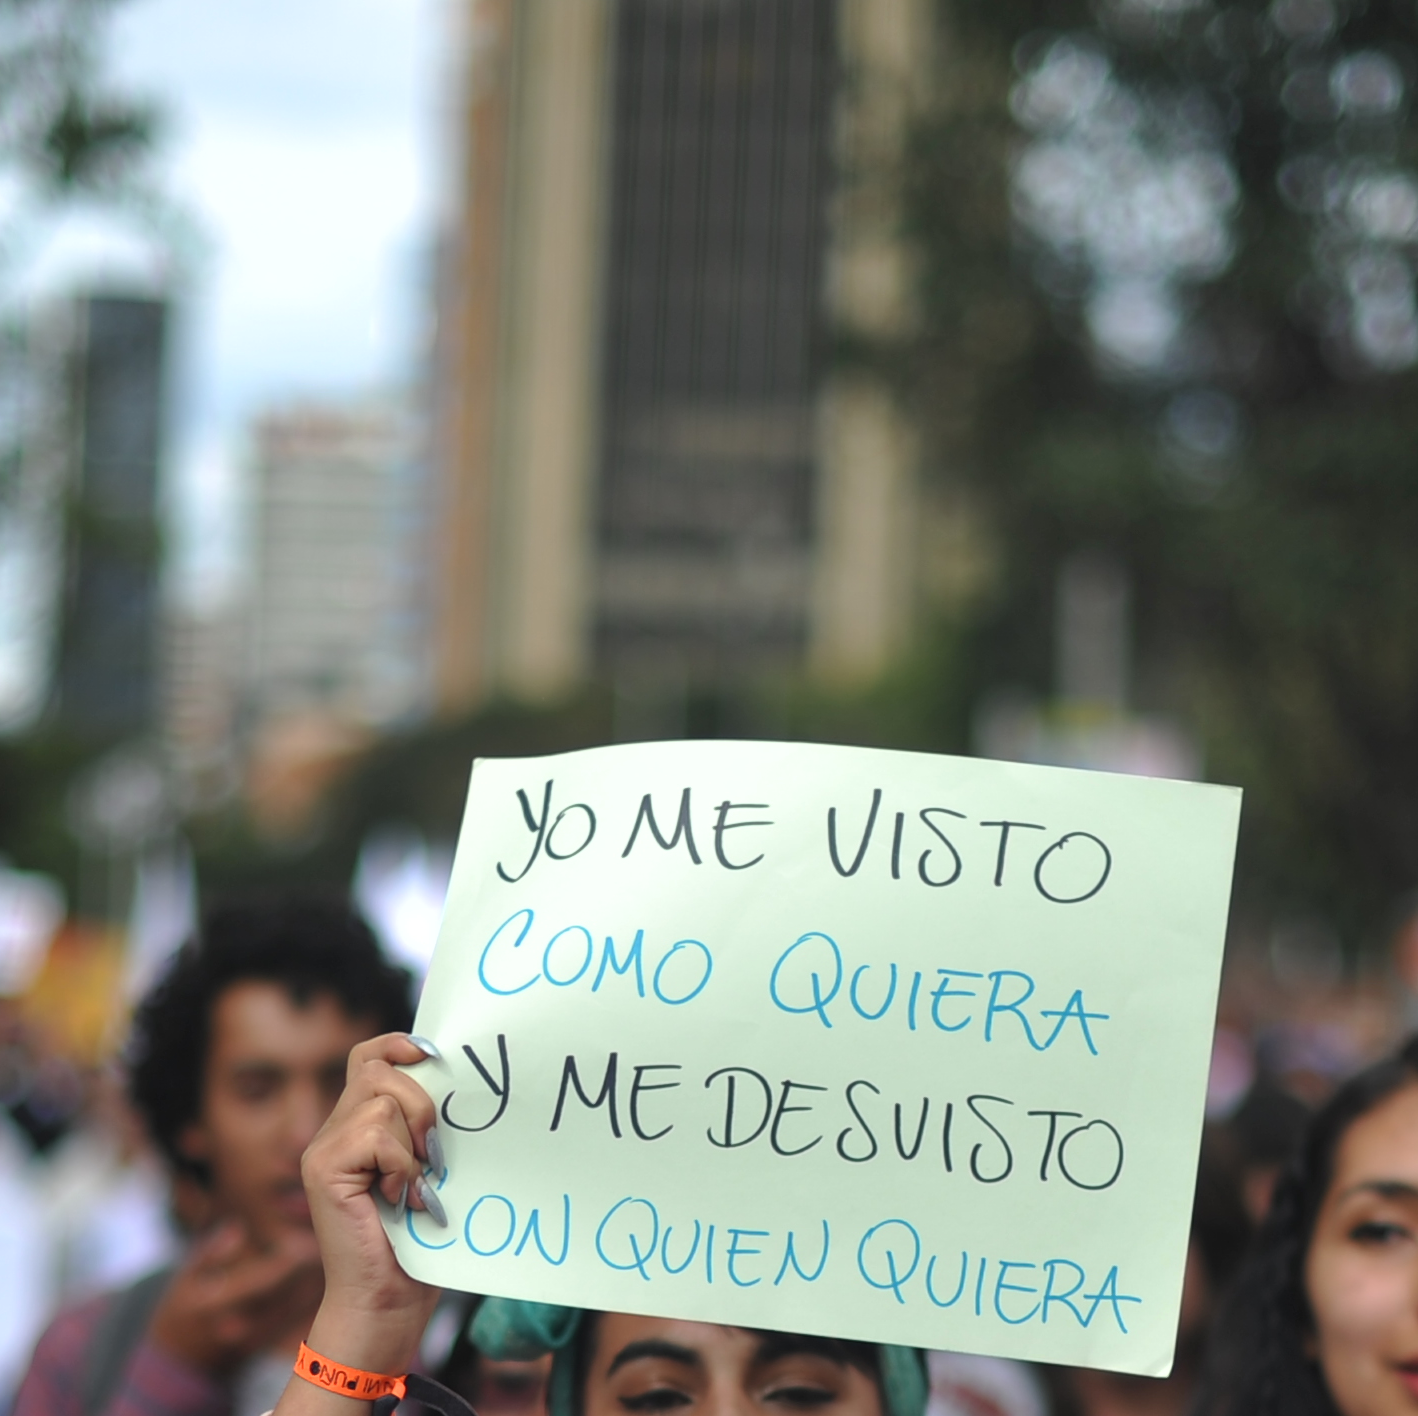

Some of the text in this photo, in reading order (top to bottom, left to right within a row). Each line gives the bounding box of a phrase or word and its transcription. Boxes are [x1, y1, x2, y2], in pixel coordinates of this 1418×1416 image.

[621, 787, 774, 870] ME
[828, 789, 1112, 904] VISTO
[478, 909, 1110, 1056] COMO QUIERA
[550, 1052, 682, 1140] ME
[705, 1067, 1123, 1190] DESVISTO
[596, 1197, 829, 1287] QUIEN
[857, 1219, 1142, 1333] QUIERA
